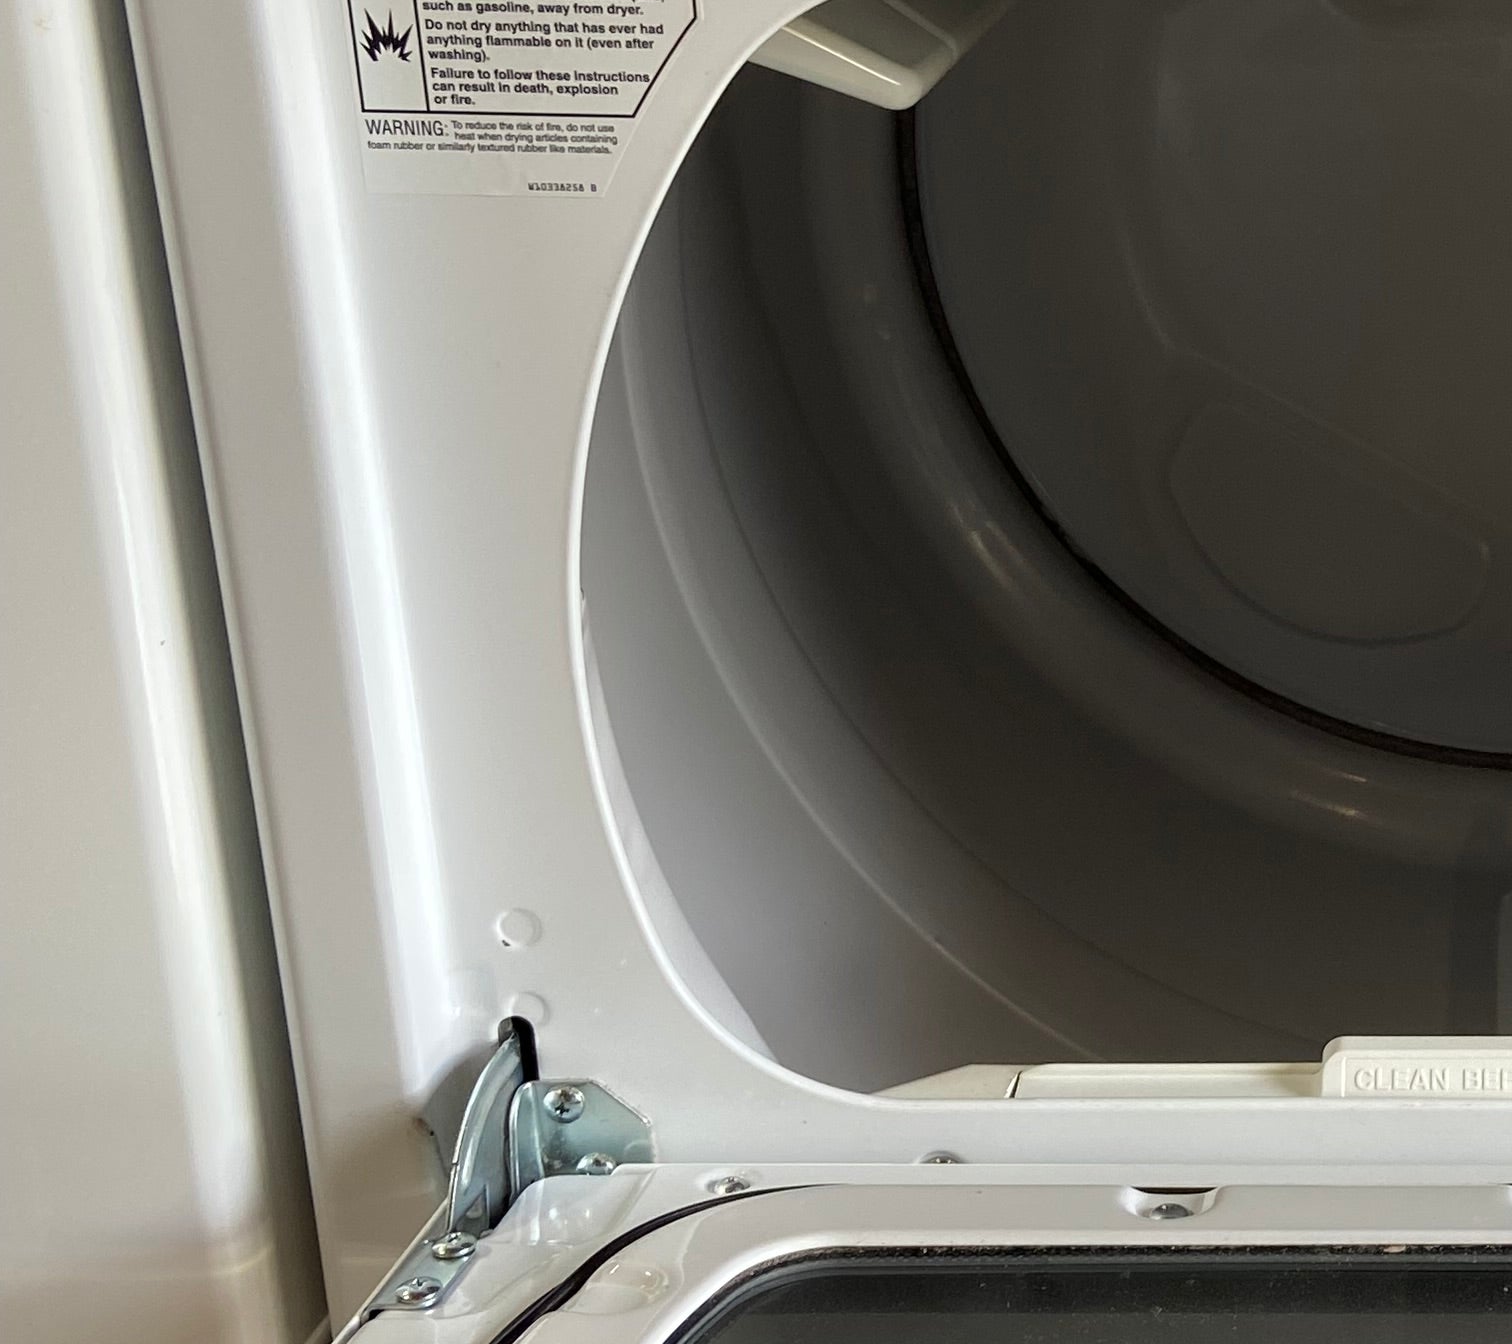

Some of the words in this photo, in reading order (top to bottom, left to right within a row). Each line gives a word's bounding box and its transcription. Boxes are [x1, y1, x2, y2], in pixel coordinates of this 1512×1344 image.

[422, 0, 454, 11] such
[457, 2, 473, 12] as
[475, 1, 534, 15] gasoline,
[537, 4, 570, 16] away
[573, 2, 604, 15] from
[607, 3, 644, 17] dryer.
[424, 18, 443, 30] Do
[446, 20, 468, 31] not
[470, 20, 492, 33] dry
[495, 21, 551, 34] anything
[553, 22, 580, 33] that
[582, 22, 606, 34] has
[608, 25, 637, 34] ever
[639, 23, 664, 35] had
[426, 34, 483, 49] anything
[485, 35, 552, 48] flammable
[555, 38, 572, 48] on
[574, 36, 584, 48] it
[586, 37, 622, 51] (even
[625, 38, 654, 49] after
[427, 48, 490, 63] washing).
[430, 67, 475, 79] Failure
[477, 69, 491, 80] to
[493, 69, 533, 81] follow
[535, 70, 571, 82] these
[432, 82, 456, 92] can
[458, 81, 496, 93] result
[498, 82, 511, 93] in
[514, 82, 554, 95] death,
[556, 83, 619, 97] explosion
[434, 95, 448, 105] or
[450, 93, 476, 105] fire.
[365, 119, 449, 137] WARNING:
[1353, 1067, 1448, 1093] CLEAN
